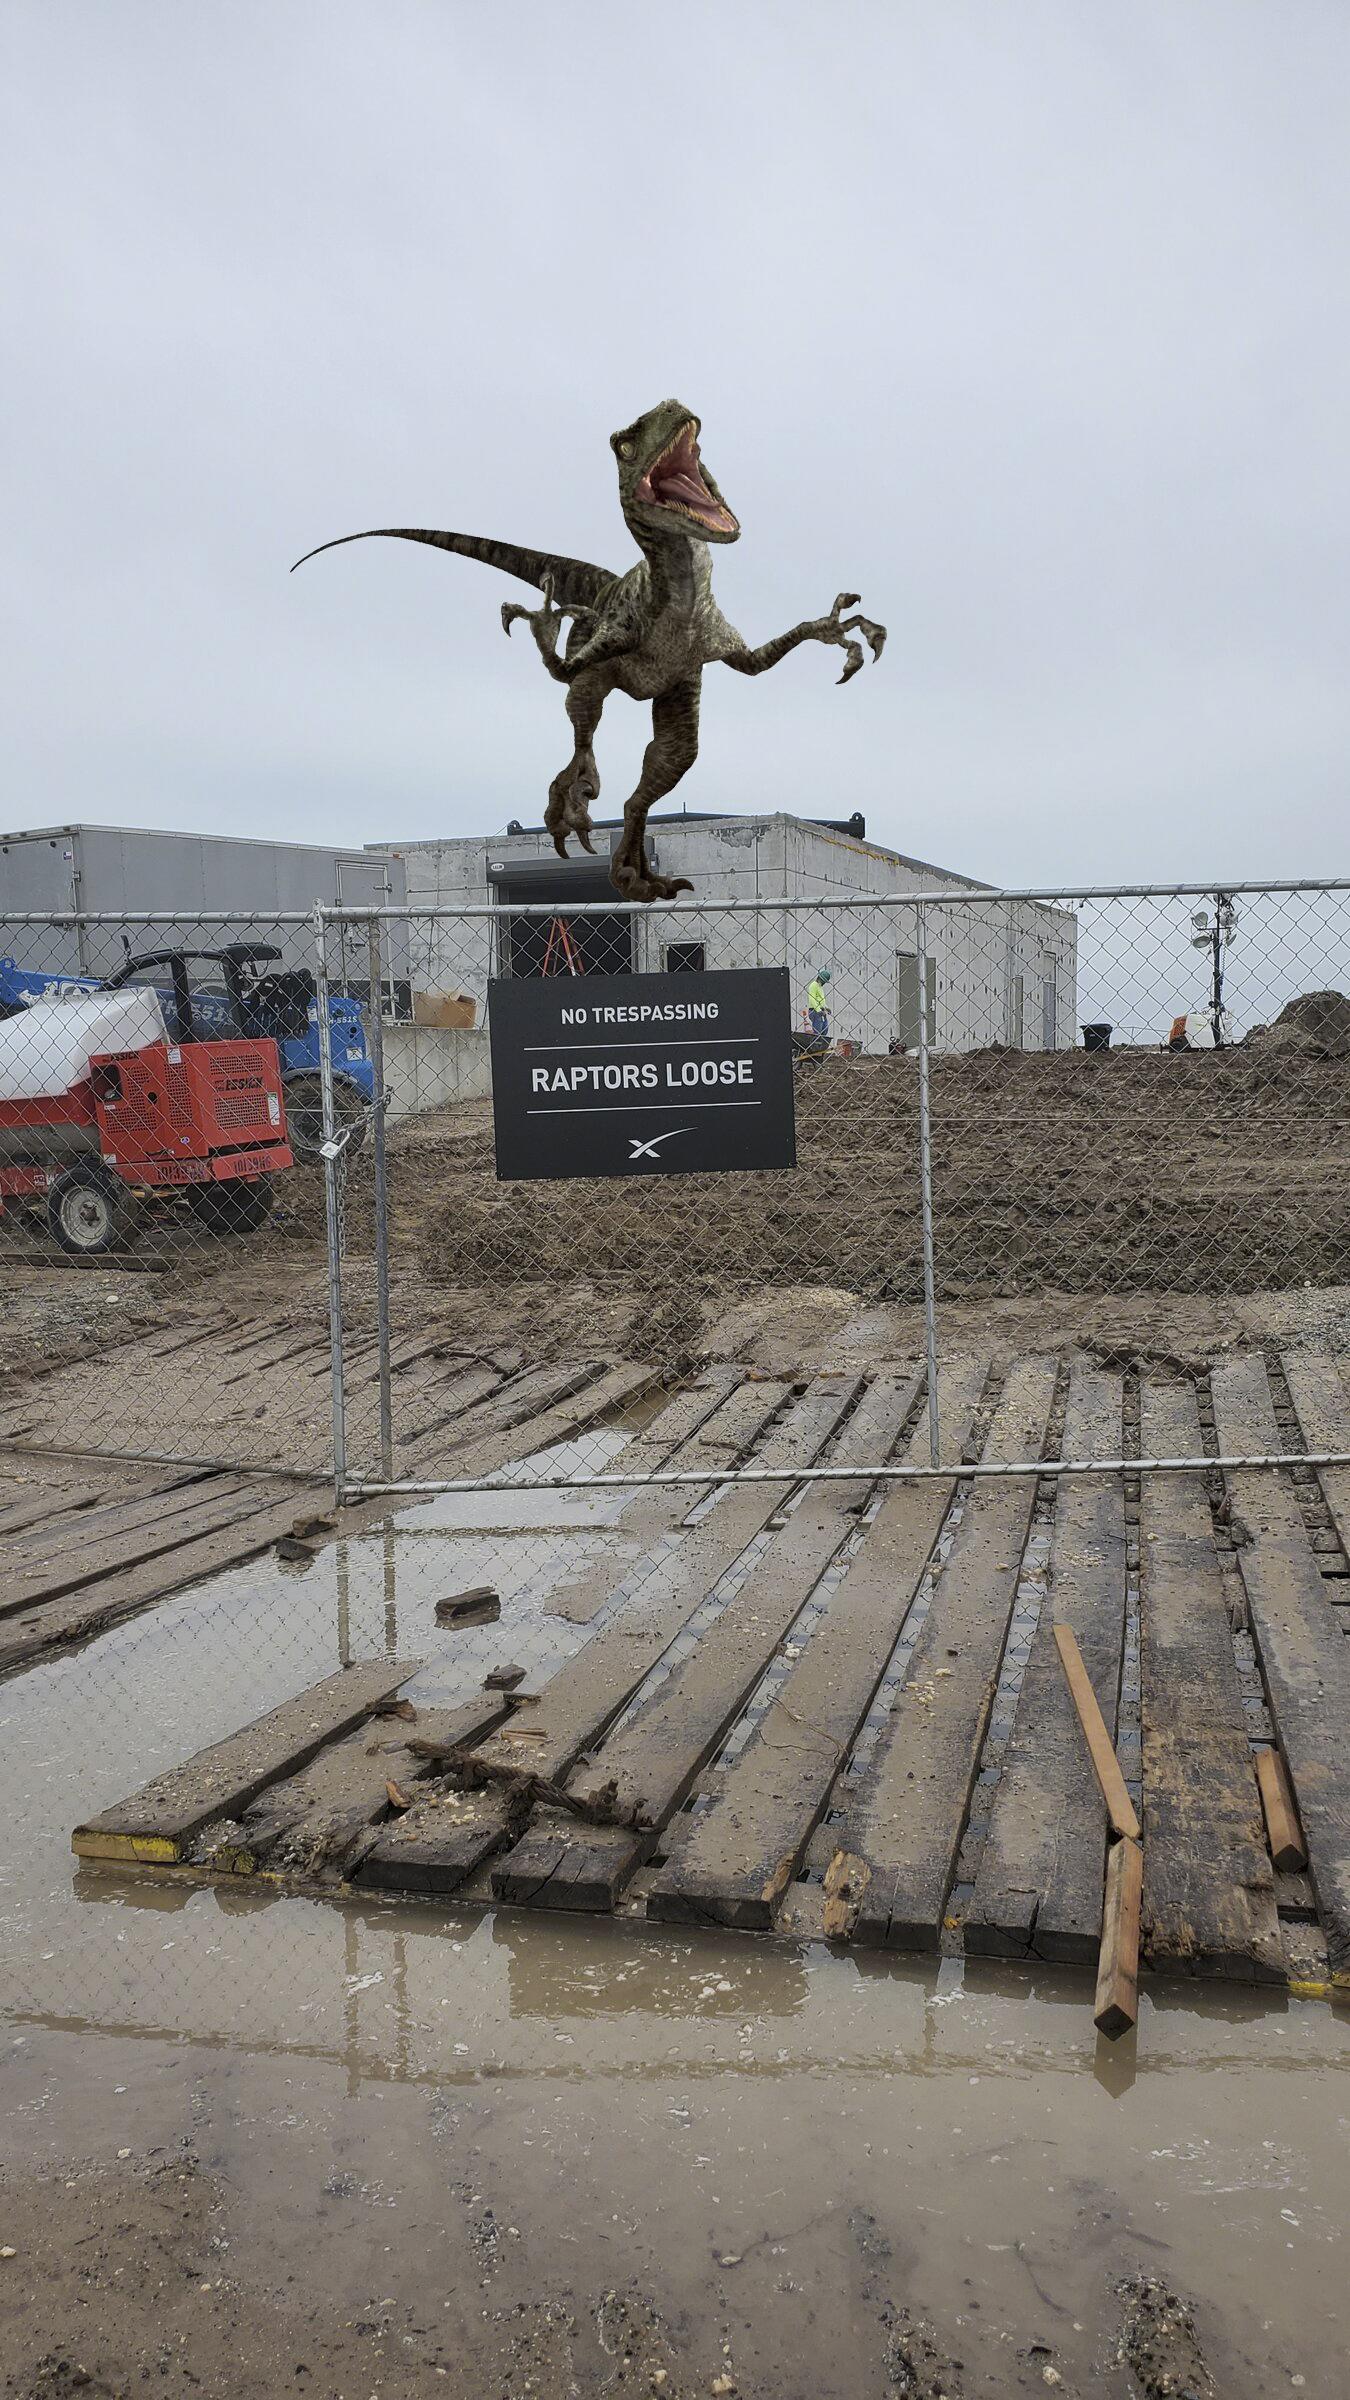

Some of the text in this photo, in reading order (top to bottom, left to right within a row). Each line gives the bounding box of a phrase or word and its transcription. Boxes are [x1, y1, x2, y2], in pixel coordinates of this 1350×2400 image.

[561, 1003, 719, 1025] NO TRESPASSING
[532, 1060, 754, 1092] RAPTORS LOOSE
